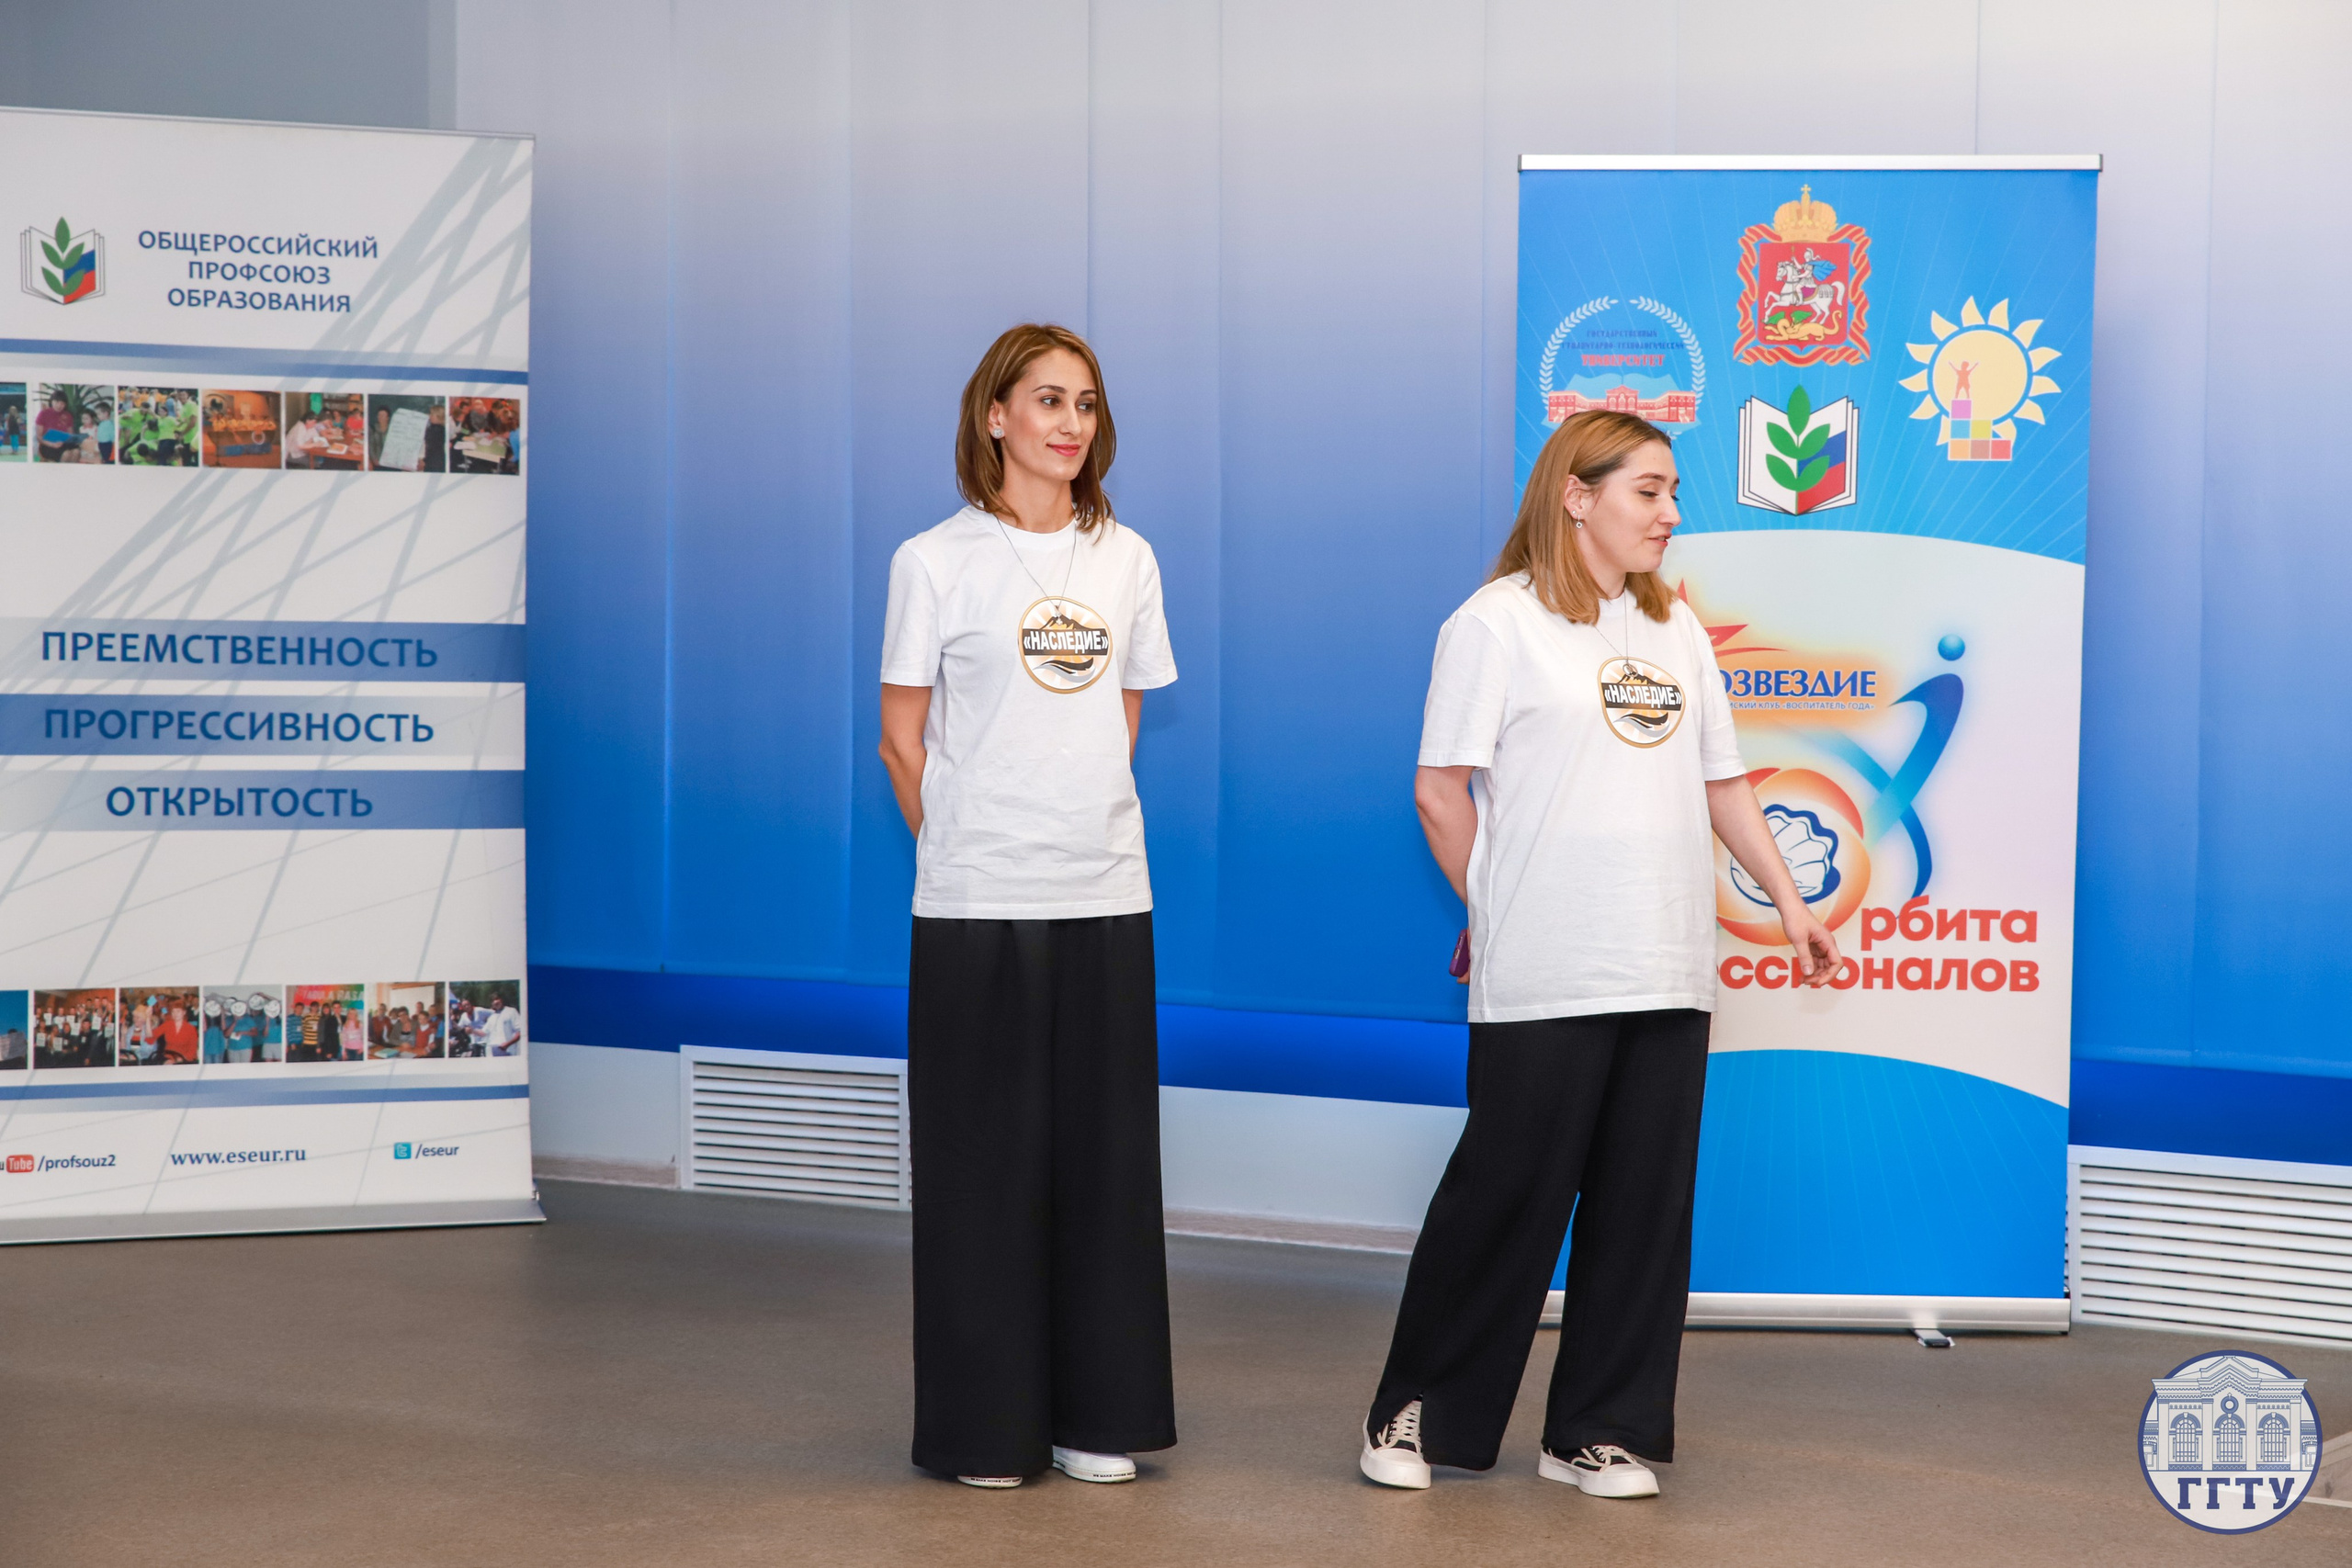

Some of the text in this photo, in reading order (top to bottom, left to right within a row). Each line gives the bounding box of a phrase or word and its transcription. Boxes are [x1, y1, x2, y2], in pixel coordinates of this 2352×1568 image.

[138, 230, 379, 258] ОБЩЕРОССИЙСКИЙ
[188, 261, 331, 285] ПРОФСОЮЗ
[167, 288, 351, 312] ОБРАЗОВАНИЯ
[41, 631, 438, 668] ПРЕЕМСТВЕННОСТЬ
[1023, 630, 1108, 654] «НАСЛЕДИЕ»
[1604, 684, 1681, 708] «НАСЛЕДИЕ»
[1848, 702, 1875, 710] ГОДА»
[45, 709, 435, 742] ПРОГРЕССИВНОСТЬ
[106, 787, 372, 817] ОТКРЫТОСТЬ
[1860, 895, 2038, 951] рбита
[1716, 955, 2041, 992] ссоналов
[38, 1155, 116, 1172] /profsouz2
[171, 1149, 307, 1166] www.eseur.ru
[414, 1144, 459, 1159] /eseur
